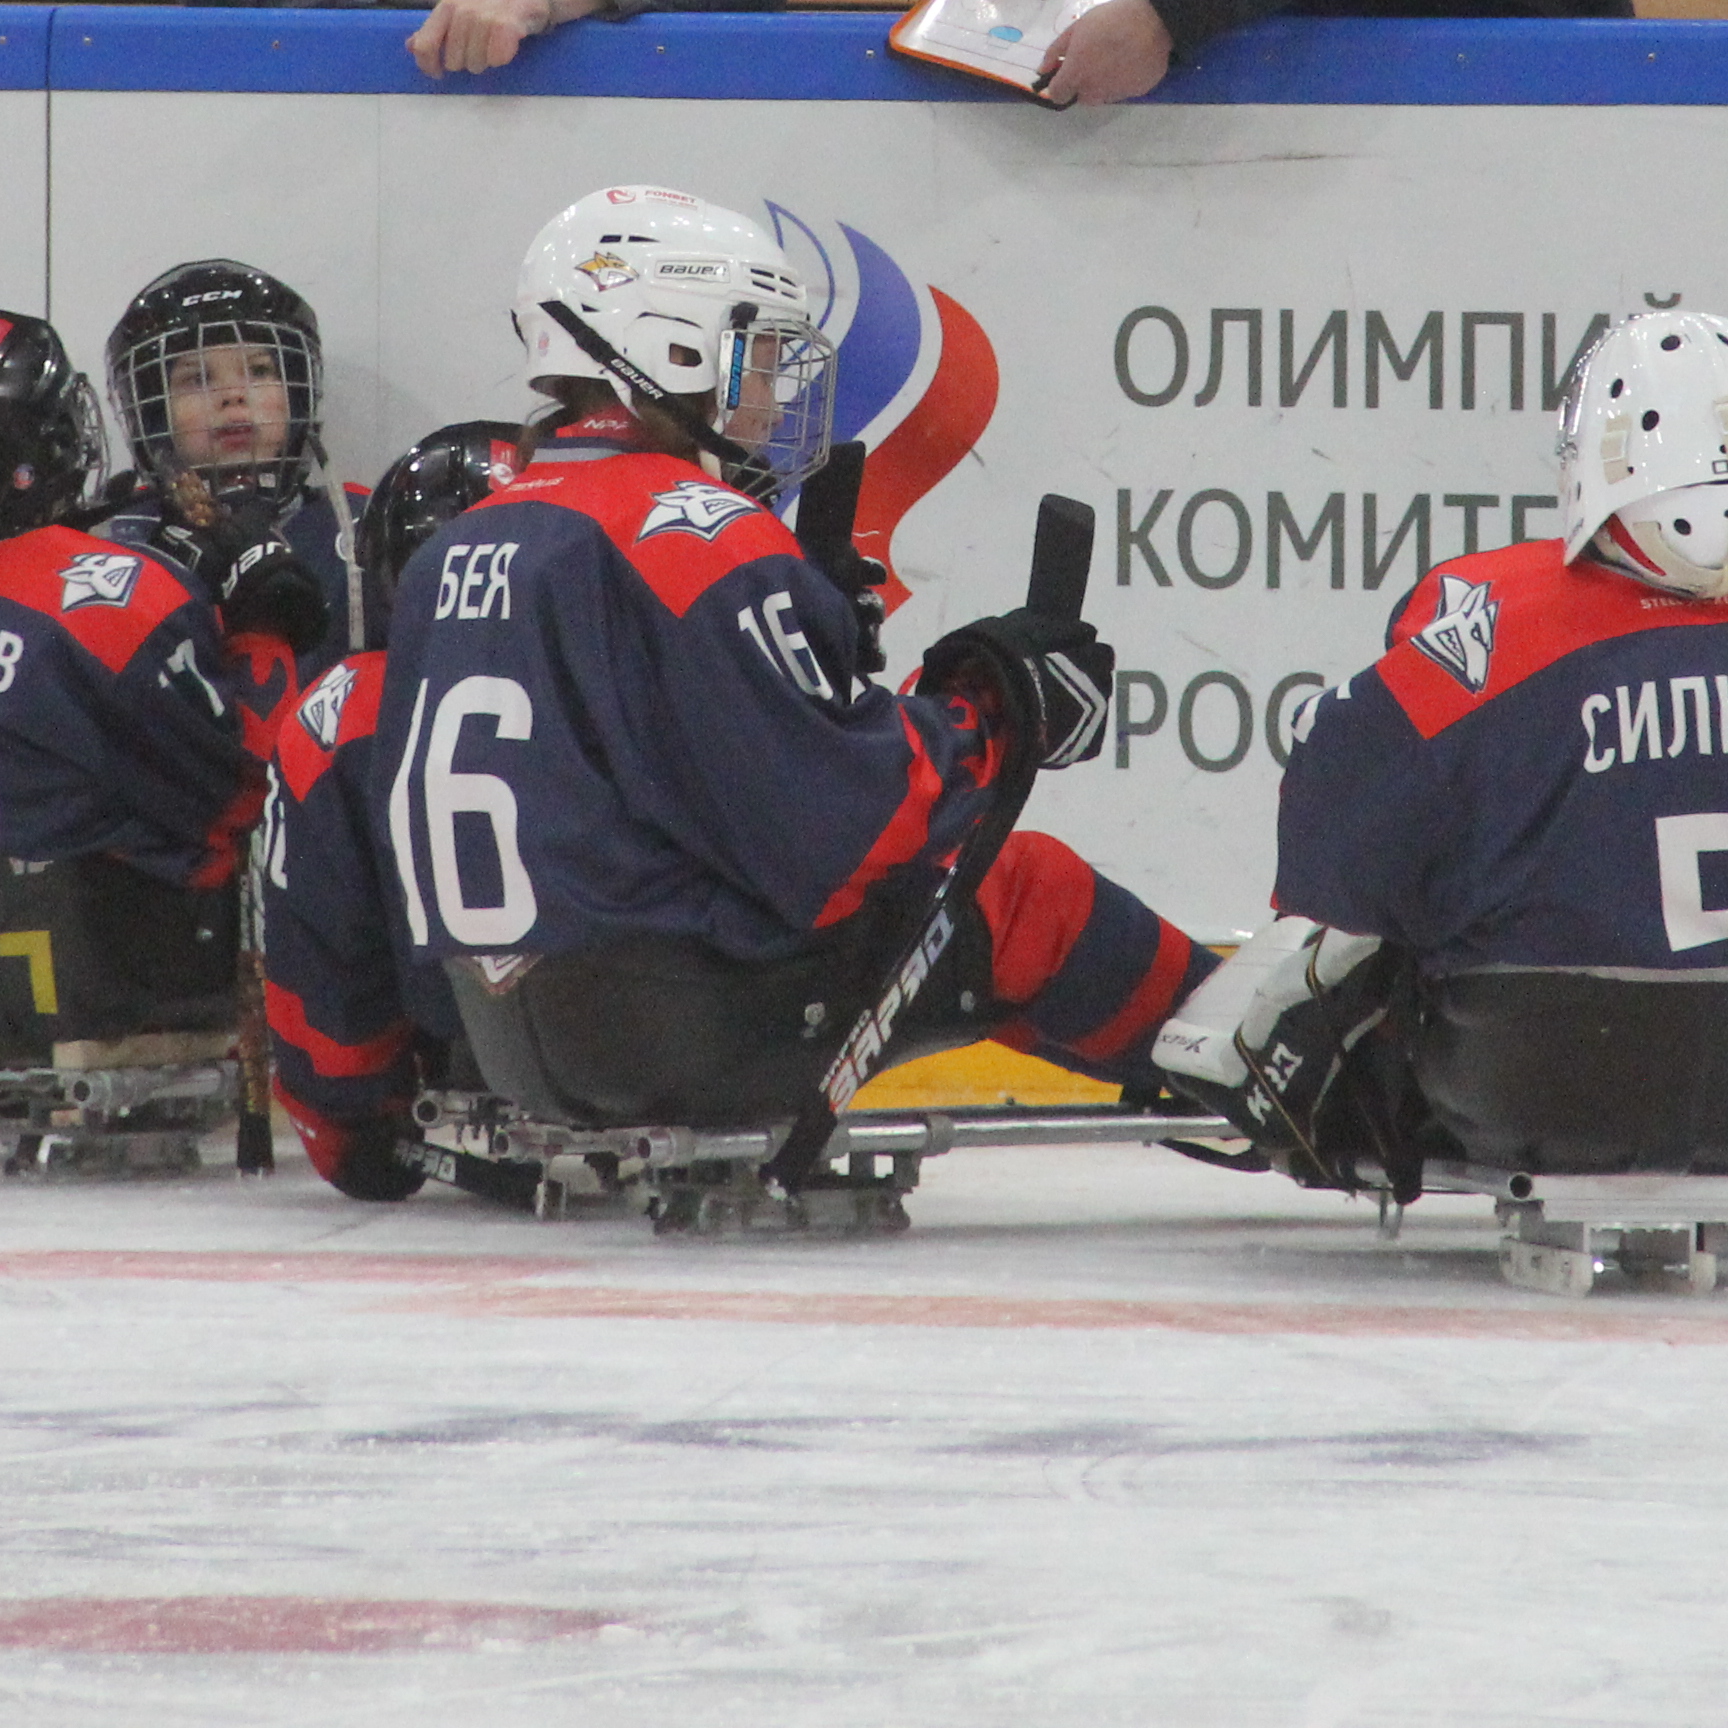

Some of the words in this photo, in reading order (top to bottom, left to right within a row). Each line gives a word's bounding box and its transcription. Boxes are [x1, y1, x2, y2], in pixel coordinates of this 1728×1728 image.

[181, 289, 244, 307] CCM
[610, 358, 664, 400] BAUER
[1116, 488, 1559, 590] КОМИТЕ
[737, 590, 836, 702] 16
[389, 675, 538, 947] 16
